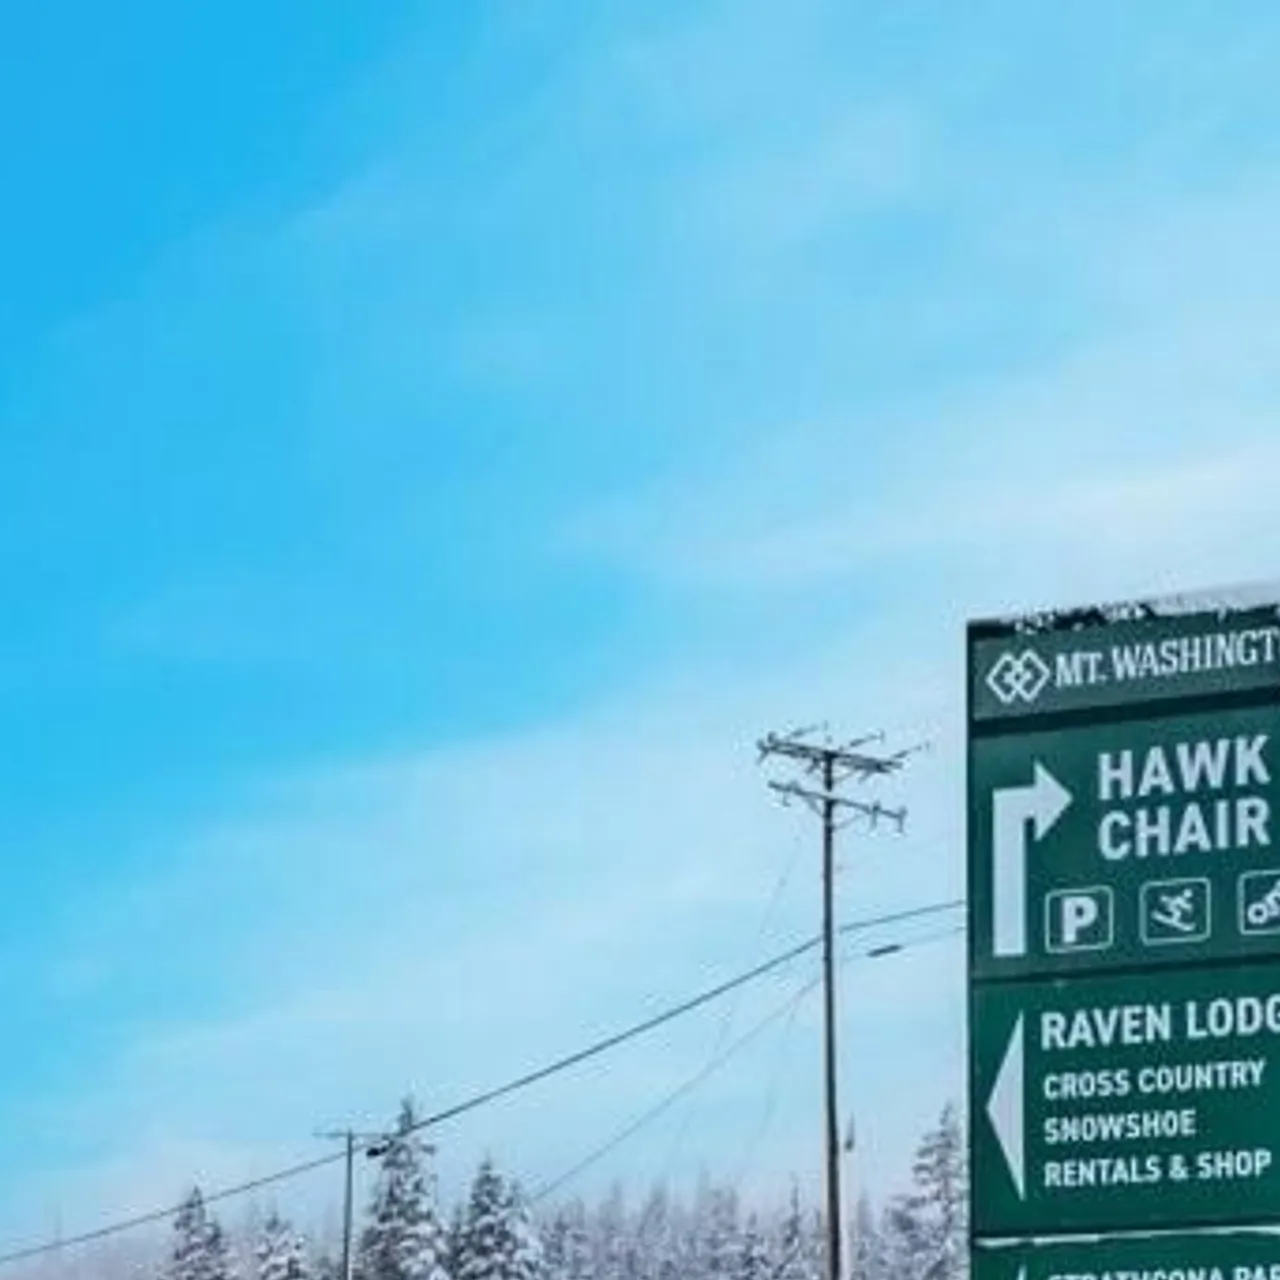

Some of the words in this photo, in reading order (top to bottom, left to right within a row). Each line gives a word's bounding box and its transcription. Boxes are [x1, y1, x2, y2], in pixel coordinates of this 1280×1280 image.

[1055, 652, 1108, 688] MT.
[1098, 734, 1271, 801] HAWK
[1098, 797, 1271, 861] CHAIR
[1040, 1003, 1171, 1050] RAVEN
[1043, 1069, 1131, 1101] CROSS
[1137, 1058, 1267, 1093] COUNTRY
[1044, 1109, 1197, 1145] SNOWSHOE
[1044, 1156, 1162, 1187] RENTALS
[1169, 1153, 1188, 1180] &
[1198, 1149, 1272, 1179] SHOP
